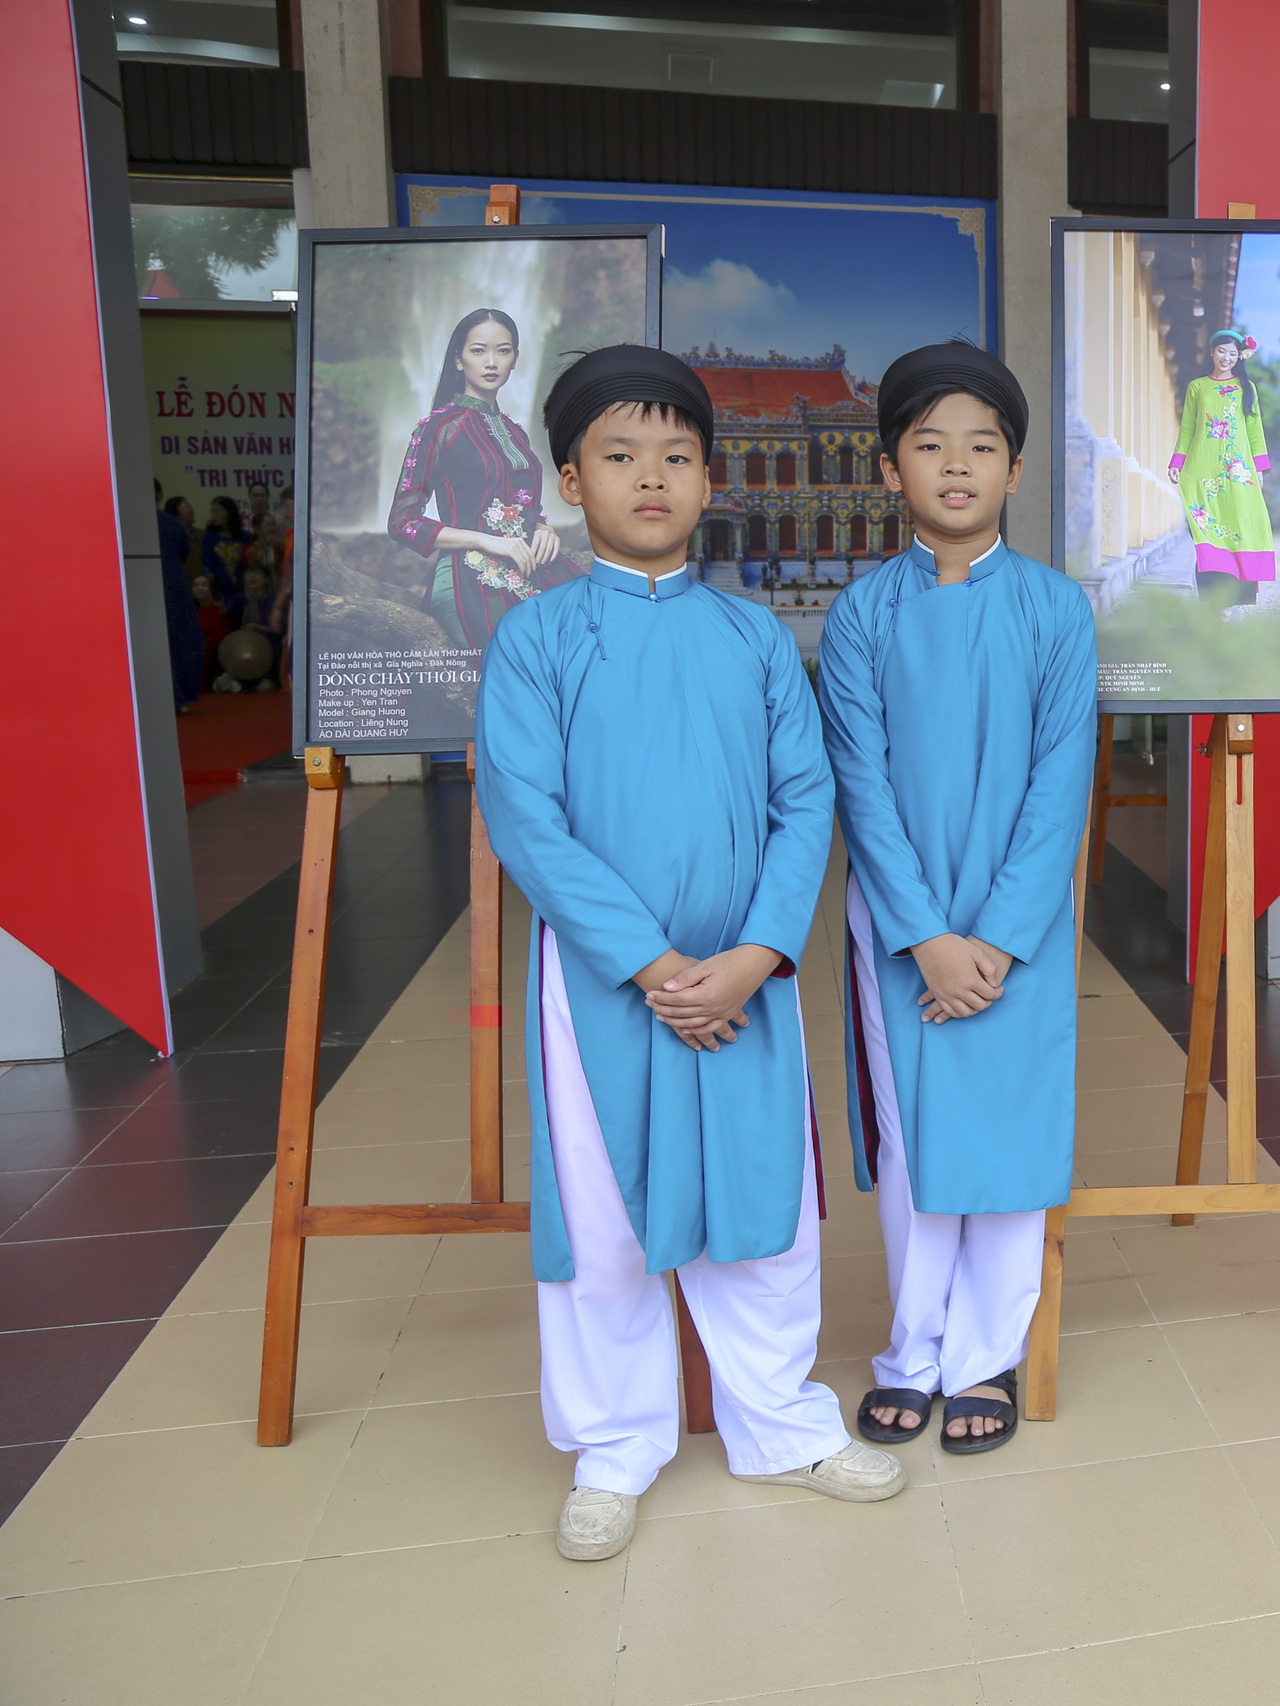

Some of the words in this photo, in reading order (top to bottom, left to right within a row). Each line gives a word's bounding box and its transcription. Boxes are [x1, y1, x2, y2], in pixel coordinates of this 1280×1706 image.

[156, 376, 194, 417] LỄ
[205, 384, 266, 418] ĐÓN
[160, 436, 180, 454] DI
[186, 430, 228, 454] SẢN
[233, 432, 272, 454] VĂN
[233, 464, 284, 488] THỨC
[331, 652, 345, 661] HỘI
[318, 662, 329, 671] Tại
[318, 670, 366, 686] DÒNG
[370, 668, 414, 685] CHẢY
[416, 668, 456, 683] THỜI
[351, 688, 378, 697] Phong
[380, 688, 412, 697] Nguyen
[351, 708, 376, 717] Giang
[379, 708, 406, 716] Huong
[361, 719, 384, 728] Liêng
[386, 718, 408, 727] Nung
[335, 728, 350, 738] DÀI
[353, 729, 387, 738] QUANG
